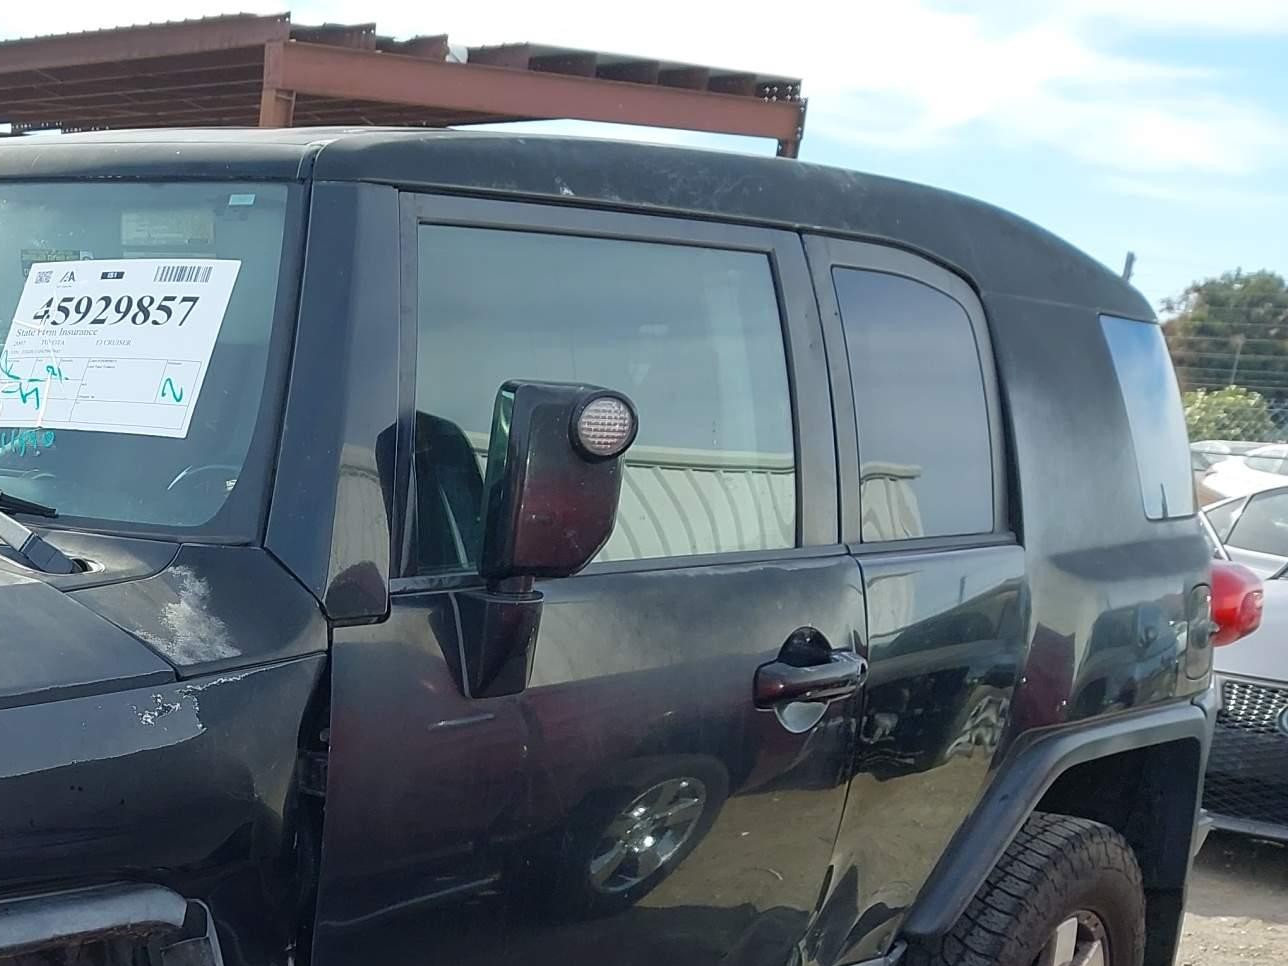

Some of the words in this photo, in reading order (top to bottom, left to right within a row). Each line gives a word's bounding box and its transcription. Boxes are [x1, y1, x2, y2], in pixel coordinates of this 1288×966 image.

[32, 295, 200, 327] 45929857
[15, 327, 36, 338] State
[58, 326, 99, 337] Insurance
